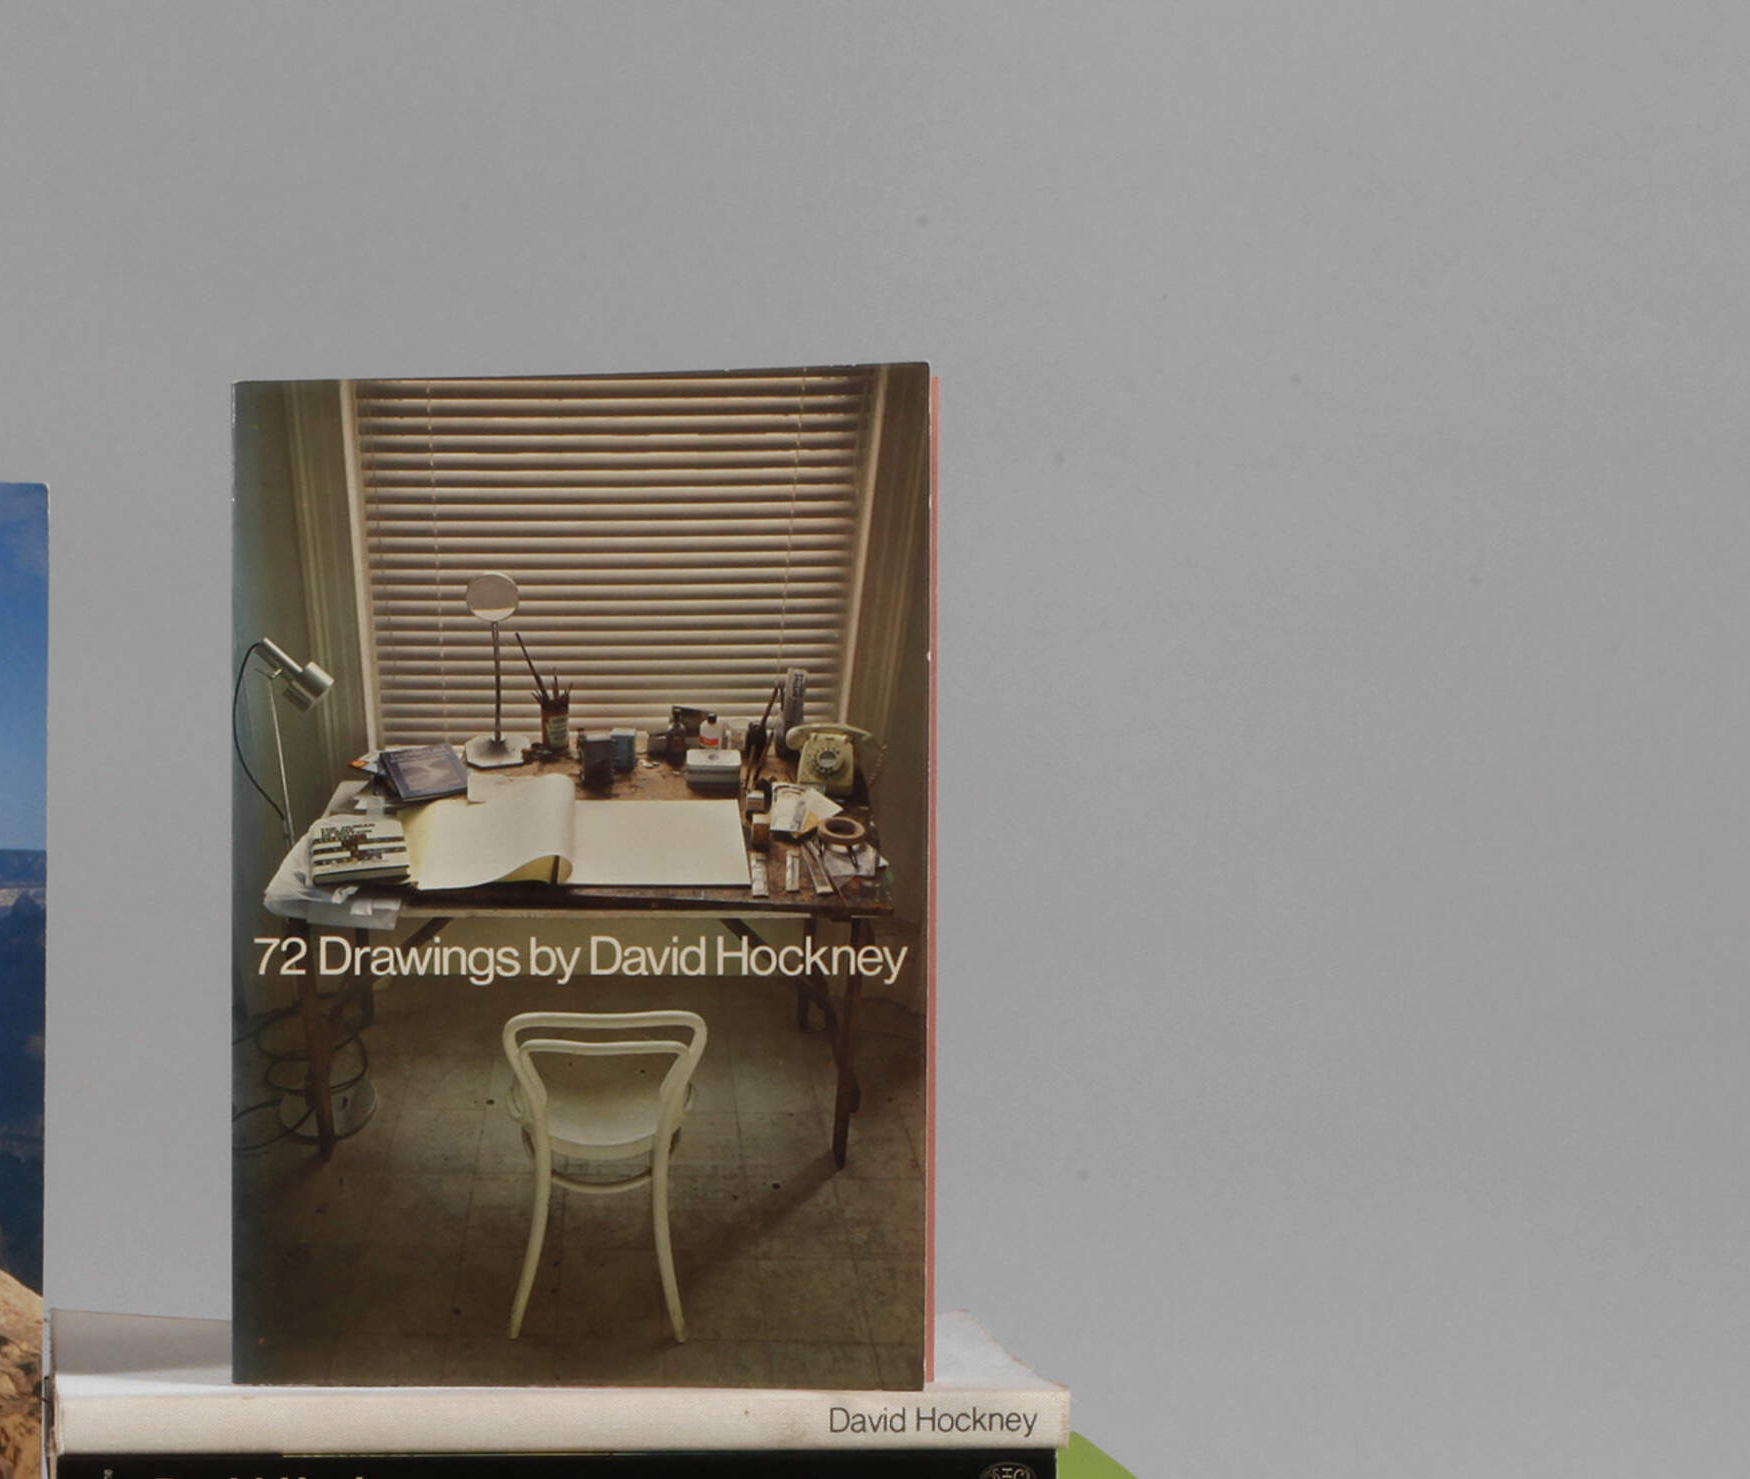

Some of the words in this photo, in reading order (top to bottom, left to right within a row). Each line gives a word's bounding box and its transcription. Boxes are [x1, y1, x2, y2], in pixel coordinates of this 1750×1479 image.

[253, 937, 307, 977] 72
[319, 936, 520, 985] Drawings
[529, 935, 580, 985] by
[589, 935, 707, 977] David
[715, 935, 908, 984] Hockney
[828, 1406, 907, 1434] David
[914, 1406, 1038, 1439] Hockney
